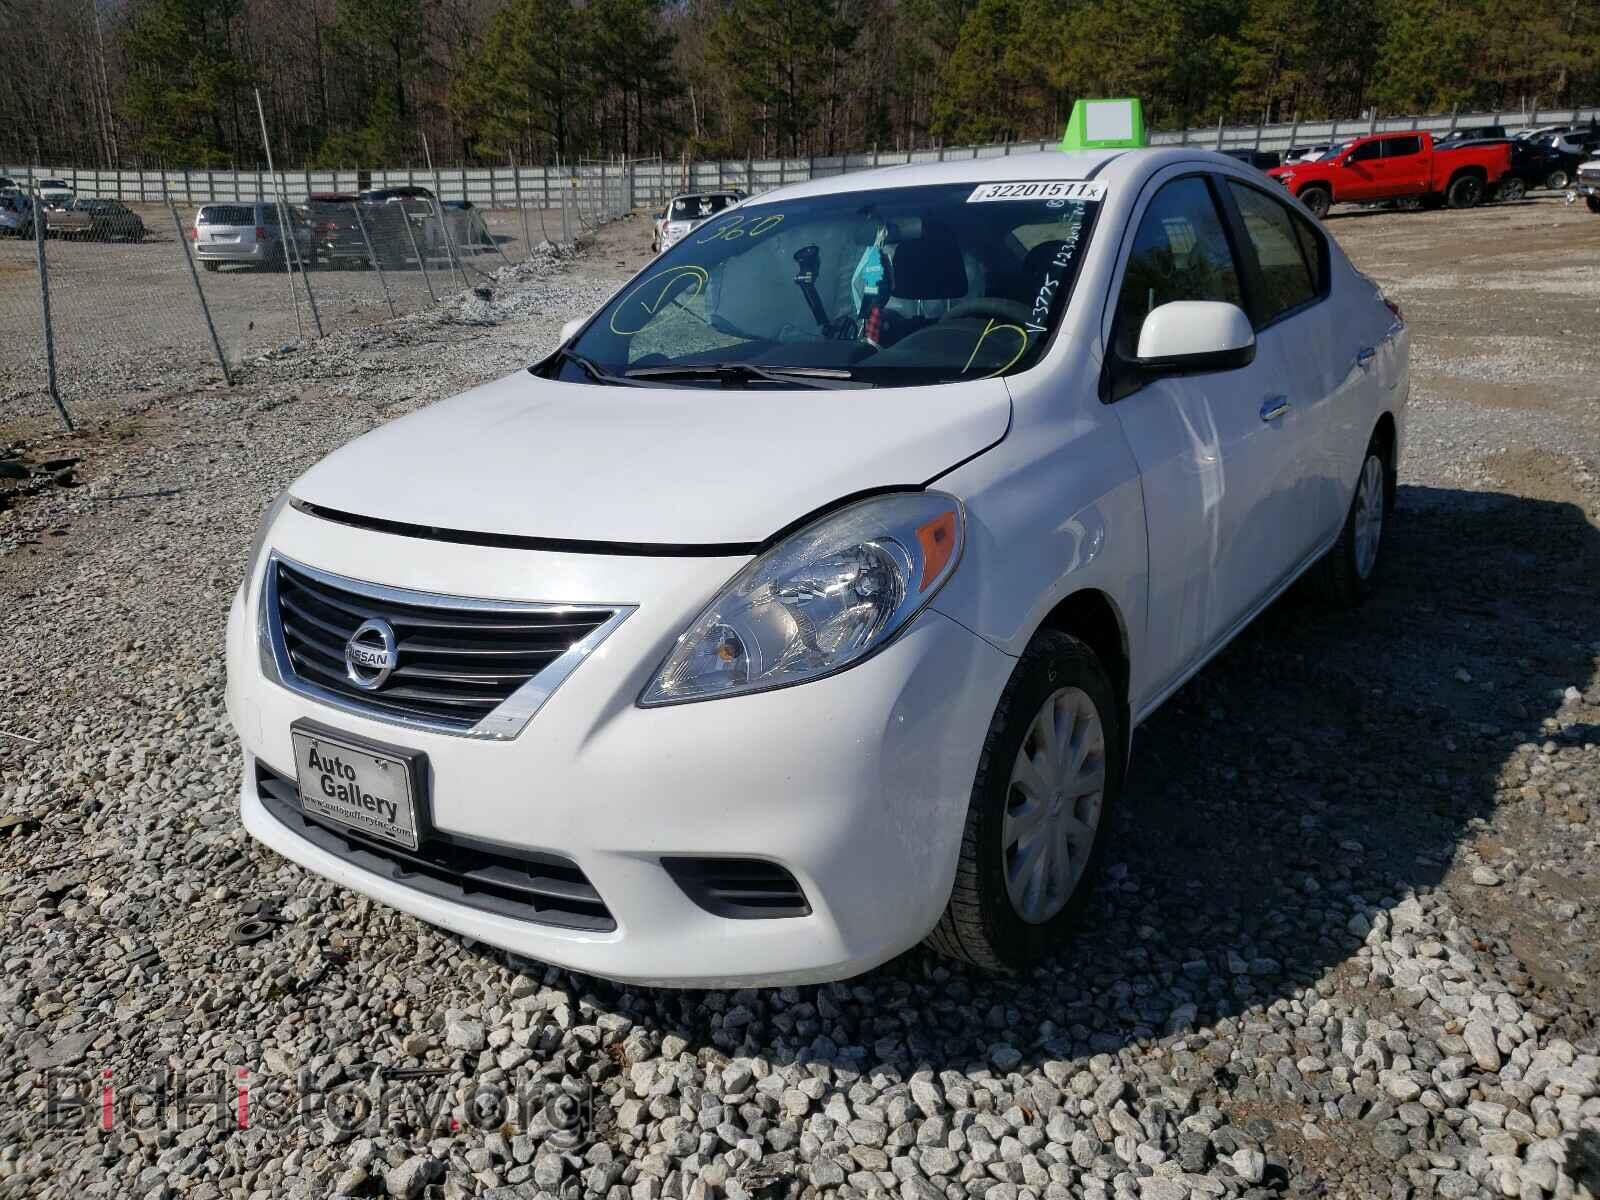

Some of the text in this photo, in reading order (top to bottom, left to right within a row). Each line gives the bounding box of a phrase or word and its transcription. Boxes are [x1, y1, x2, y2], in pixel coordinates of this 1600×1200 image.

[986, 183, 1088, 198] 32201511
[345, 647, 388, 665] NISSAN
[308, 748, 357, 781] Auto
[320, 774, 398, 823] Gallery
